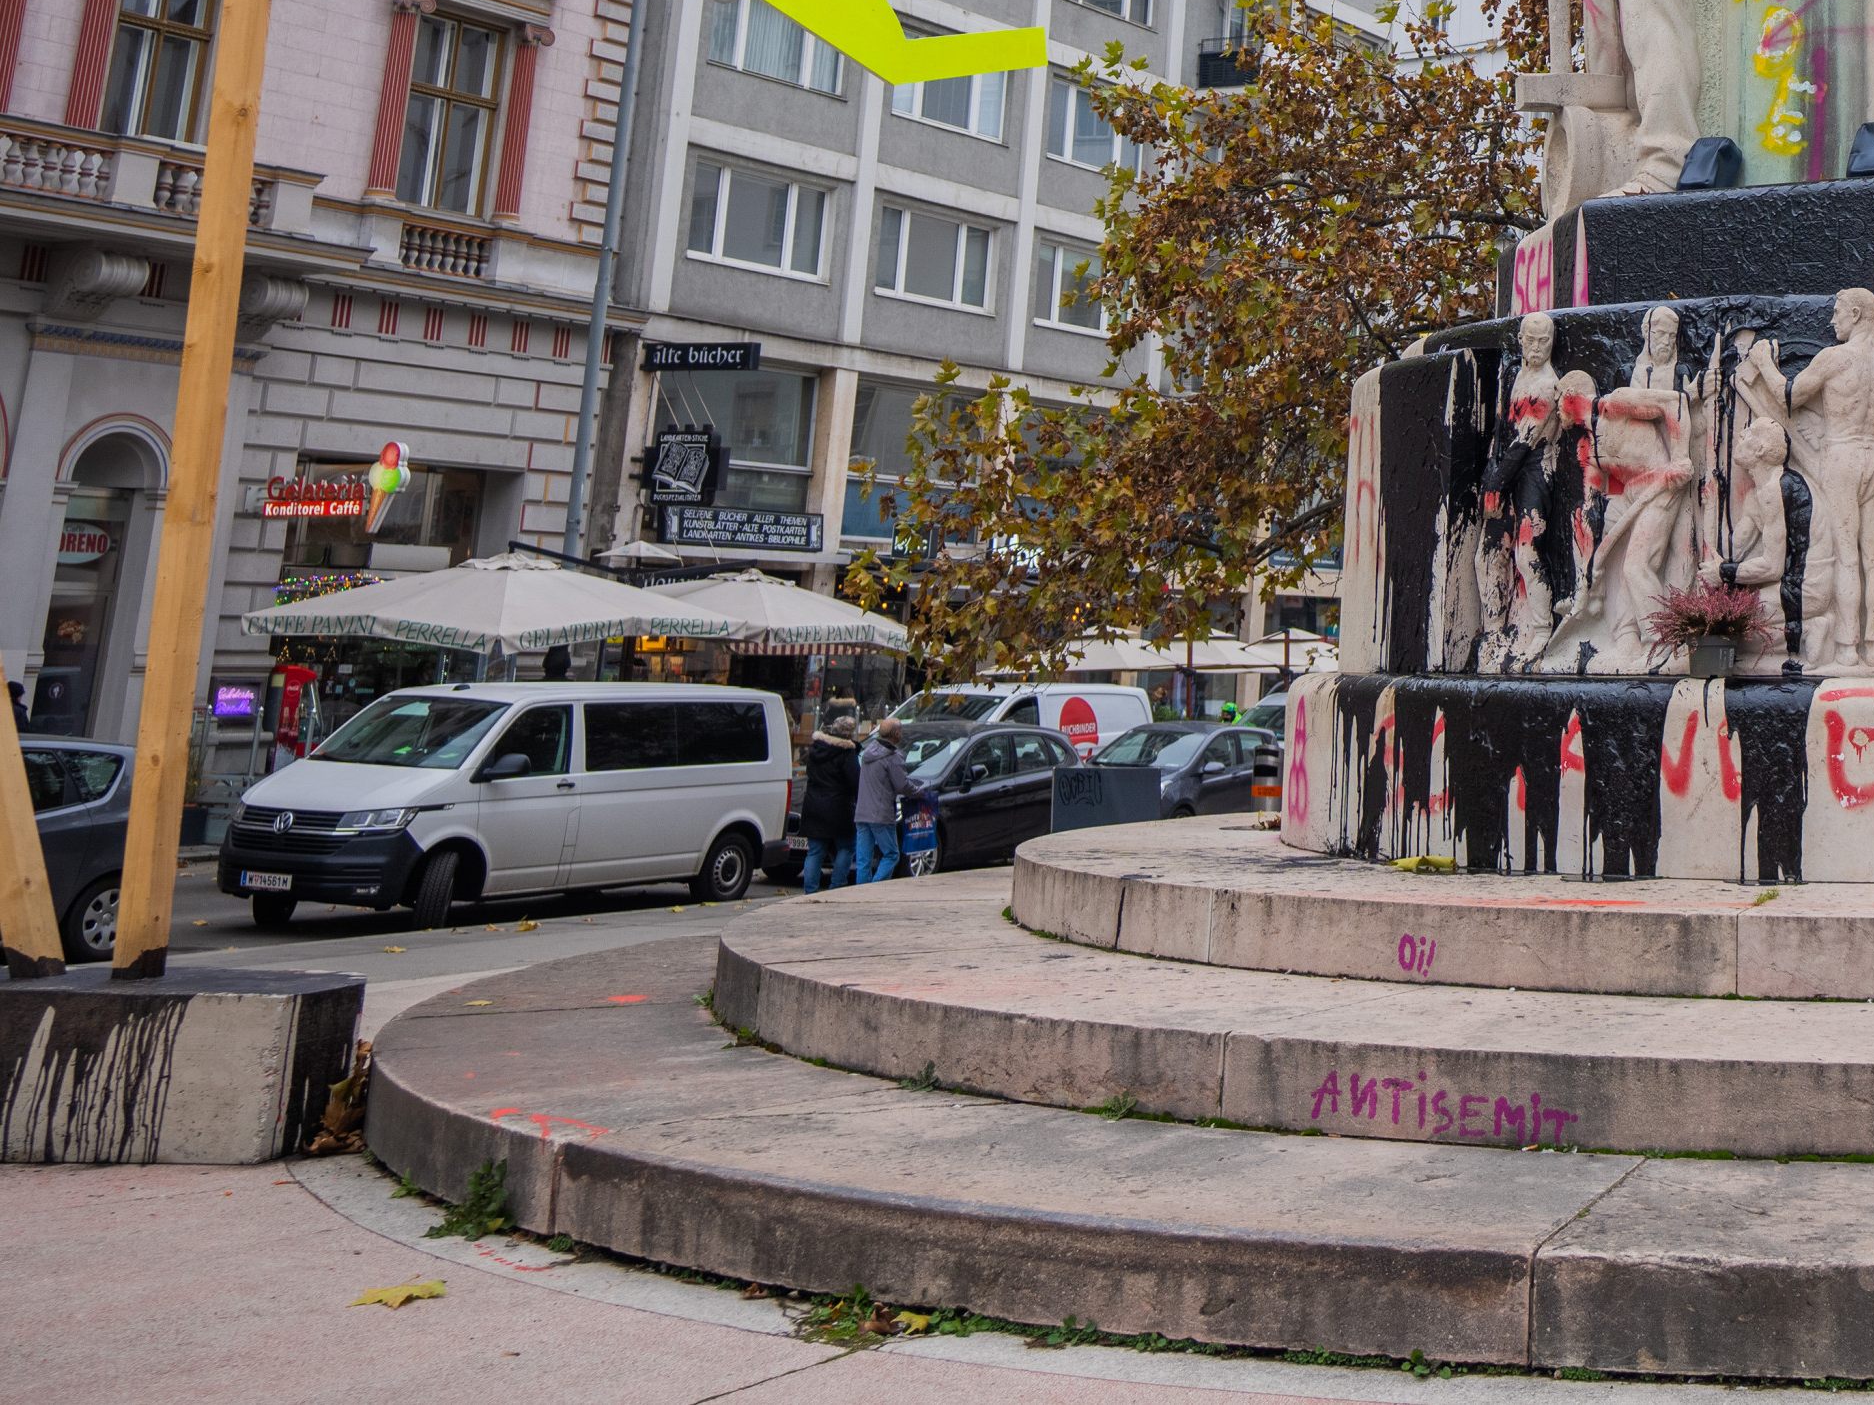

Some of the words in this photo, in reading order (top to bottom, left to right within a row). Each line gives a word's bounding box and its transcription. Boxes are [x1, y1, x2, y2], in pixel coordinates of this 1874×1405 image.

[653, 345, 682, 364] alte
[688, 346, 744, 369] bücher
[267, 474, 367, 501] Gelateria
[265, 501, 325, 516] Konditorei
[683, 508, 714, 520] SELTENE
[752, 513, 775, 524] ALLER
[779, 516, 808, 526] THEMEN
[761, 525, 807, 536] POSTKARTEN
[311, 614, 377, 634] PANINI
[650, 617, 730, 637] PERRELLA
[826, 624, 876, 643] PANINI
[395, 619, 486, 651] PERRELLA
[519, 618, 625, 651] GELATERIA
[248, 873, 255, 885] W
